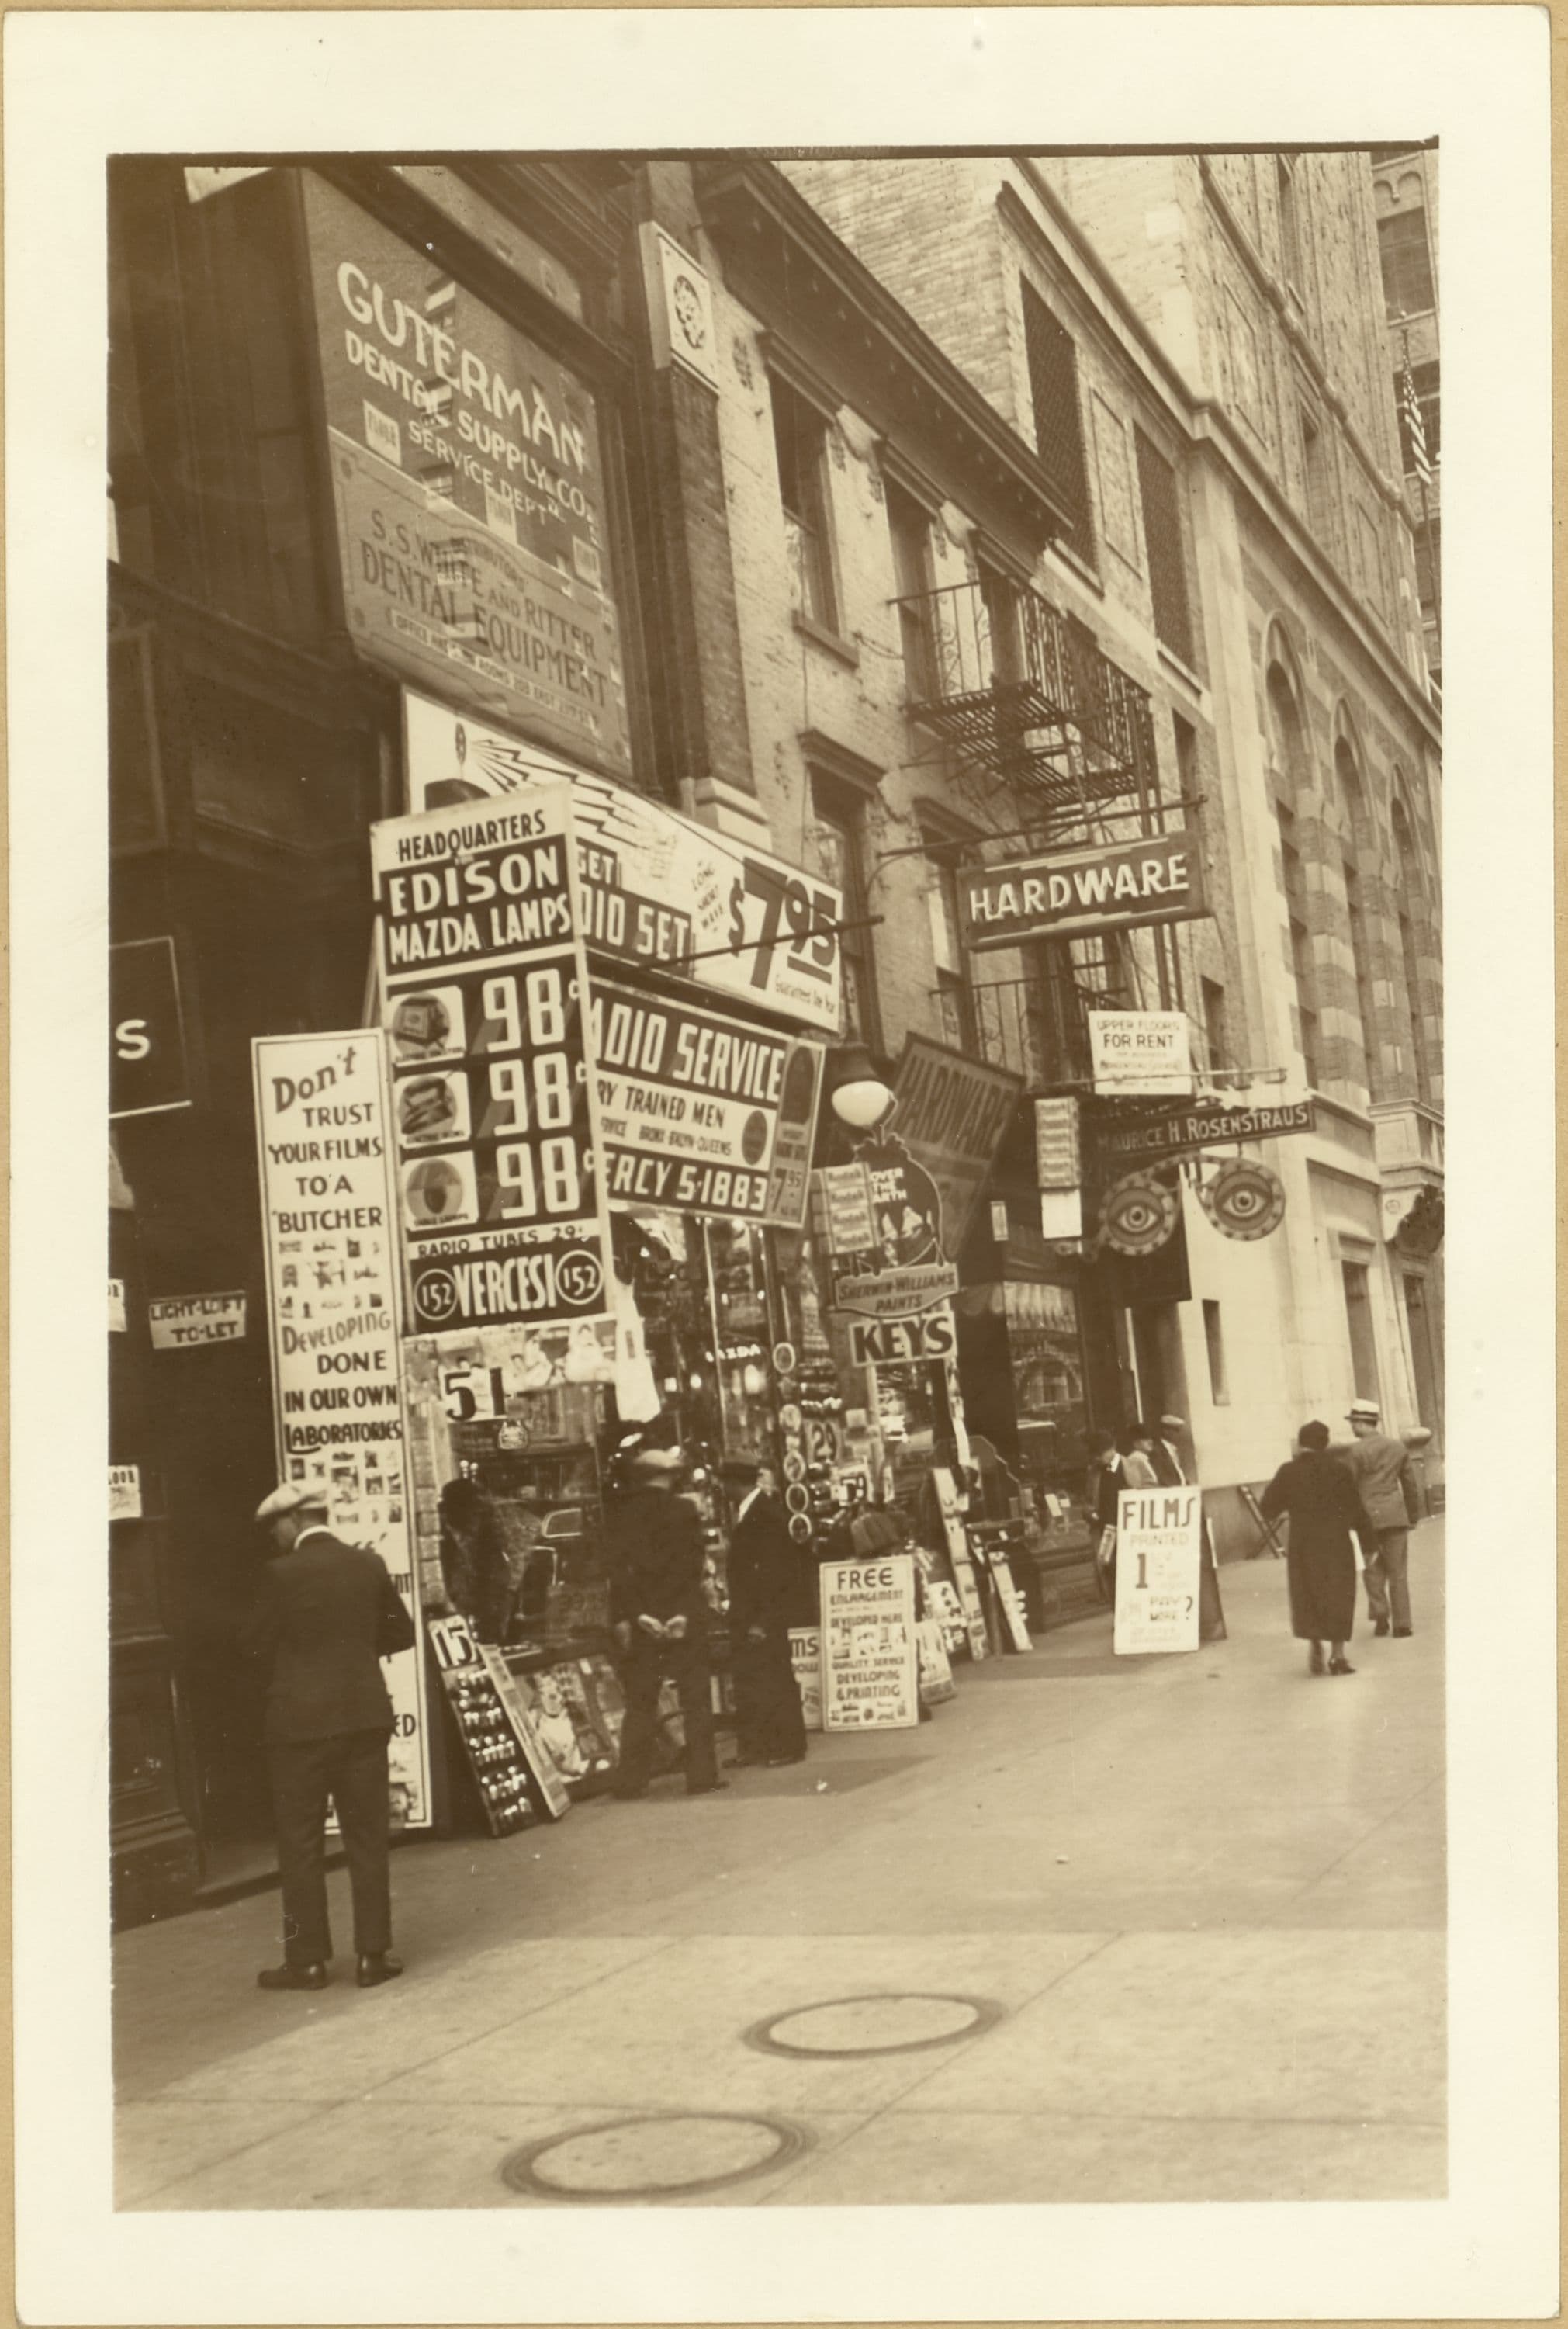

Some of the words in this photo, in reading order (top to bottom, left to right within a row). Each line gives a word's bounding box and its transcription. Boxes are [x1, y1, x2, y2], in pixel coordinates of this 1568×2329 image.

[338, 262, 587, 475] GUTERMAN
[407, 420, 493, 486] SERVICE
[457, 409, 547, 490] SUPPLY
[524, 596, 597, 660] RITTER
[472, 602, 607, 708] EQUIPMENT
[398, 809, 545, 863] HEADQUARTERS
[389, 845, 559, 917] EDISON
[970, 854, 1189, 922] HARDWARE
[389, 913, 482, 965] MAZDA
[490, 893, 572, 948] LAMPS
[635, 903, 690, 963] SET
[672, 1021, 785, 1104] SERVICE
[1102, 1033, 1132, 1049] FOR
[1135, 1033, 1174, 1049] RENT
[272, 1045, 357, 1114] Don't
[303, 1103, 374, 1128] TRUST
[625, 1084, 686, 1121] TRAINED
[691, 1101, 726, 1129] MEN
[1186, 1104, 1308, 1142] ROSENSTRAUS
[268, 1141, 321, 1165] YOUR
[324, 1136, 383, 1161] FILMS
[296, 1175, 327, 1197] TO
[334, 1174, 355, 1194] A
[417, 1239, 470, 1259] RADIO
[479, 1229, 539, 1249] TUBES
[421, 1283, 452, 1312] 152
[452, 1253, 557, 1318] VERCESI
[563, 1266, 597, 1296] 152
[875, 1294, 923, 1313] PAINTS
[317, 1350, 387, 1375] DONE
[853, 1316, 954, 1364] KEYS
[284, 1390, 306, 1413] IN
[310, 1387, 350, 1412] OUR
[353, 1384, 398, 1409] OWN
[1123, 1496, 1196, 1530] FILMS
[837, 1566, 894, 1591] FREE
[836, 1669, 901, 1685] DEVELOPING
[846, 1684, 901, 1700] PRINTING
